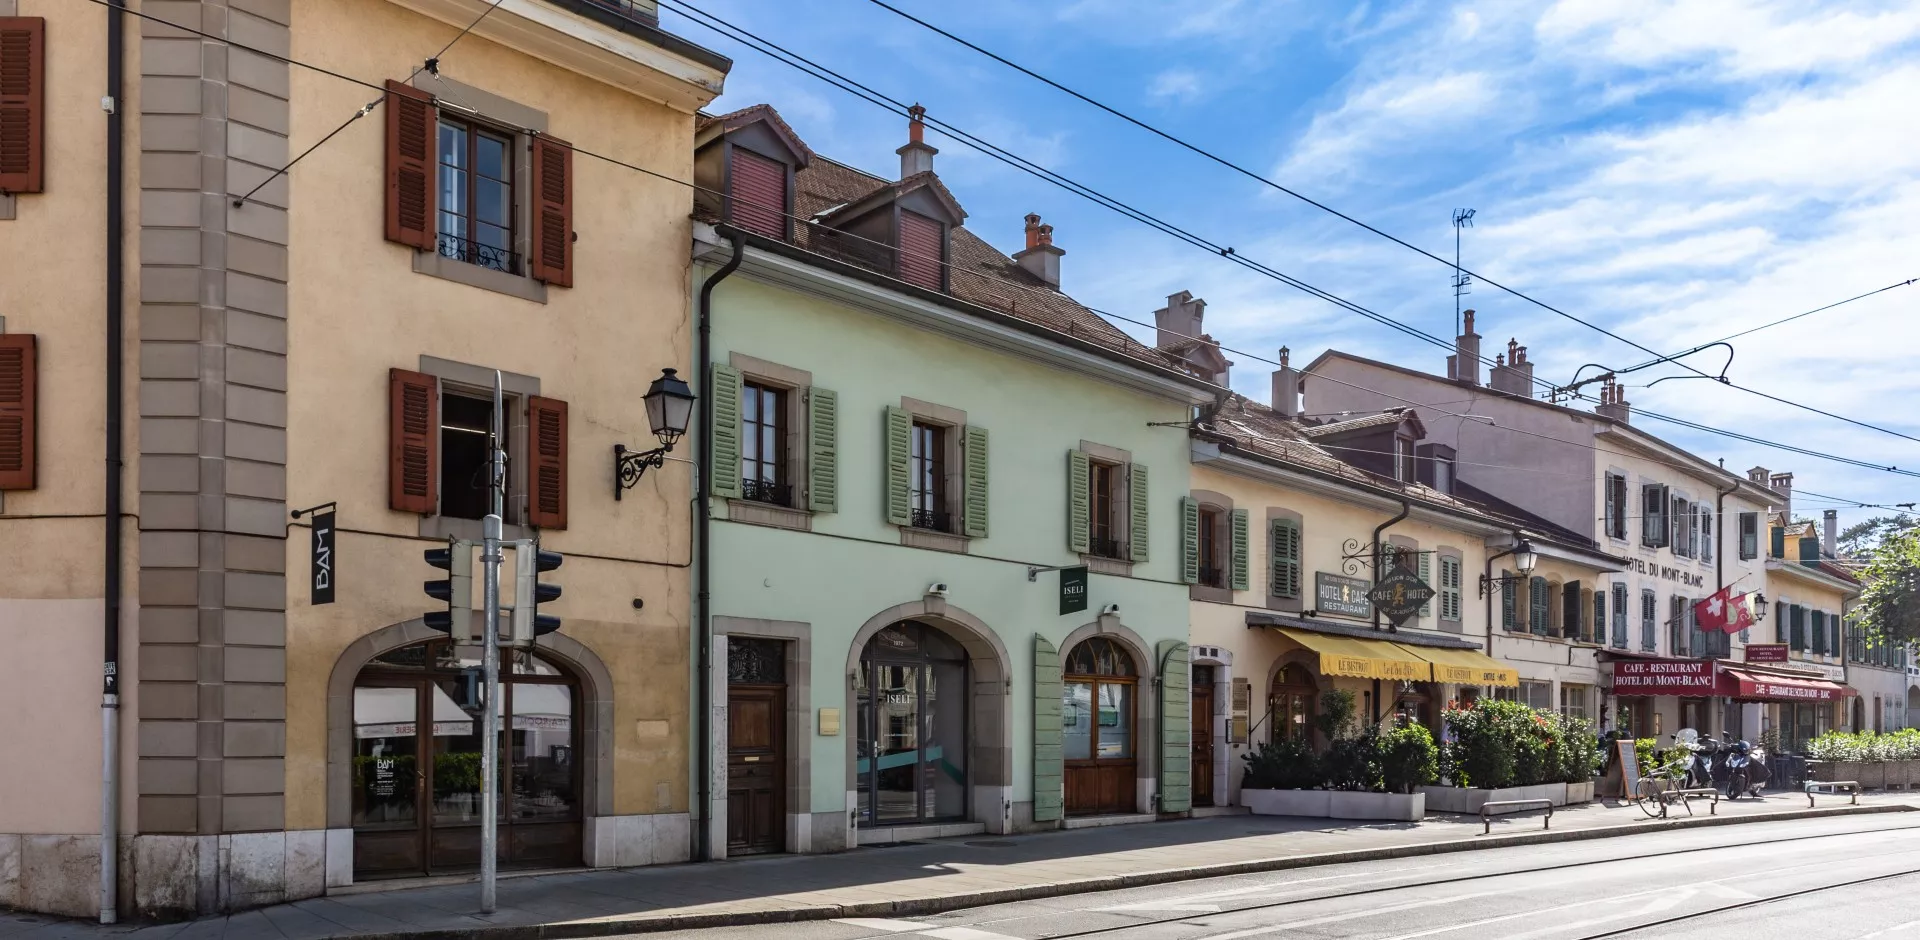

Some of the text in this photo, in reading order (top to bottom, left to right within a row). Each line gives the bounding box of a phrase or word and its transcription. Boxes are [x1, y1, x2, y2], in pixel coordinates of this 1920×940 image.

[316, 528, 330, 590] BAM
[1649, 562, 1658, 577] DU
[1661, 565, 1703, 589] MONT-BLANC
[1063, 585, 1084, 595] ISELI
[1320, 583, 1341, 601] HOTEL
[1324, 601, 1367, 614] RESTAURANT
[1624, 663, 1644, 673] CAFE
[1650, 663, 1703, 673] RESTAURANT
[1615, 676, 1642, 686] HOTEL
[1643, 676, 1655, 686] DU
[886, 694, 910, 704] ISELI
[376, 758, 394, 770] BAM
